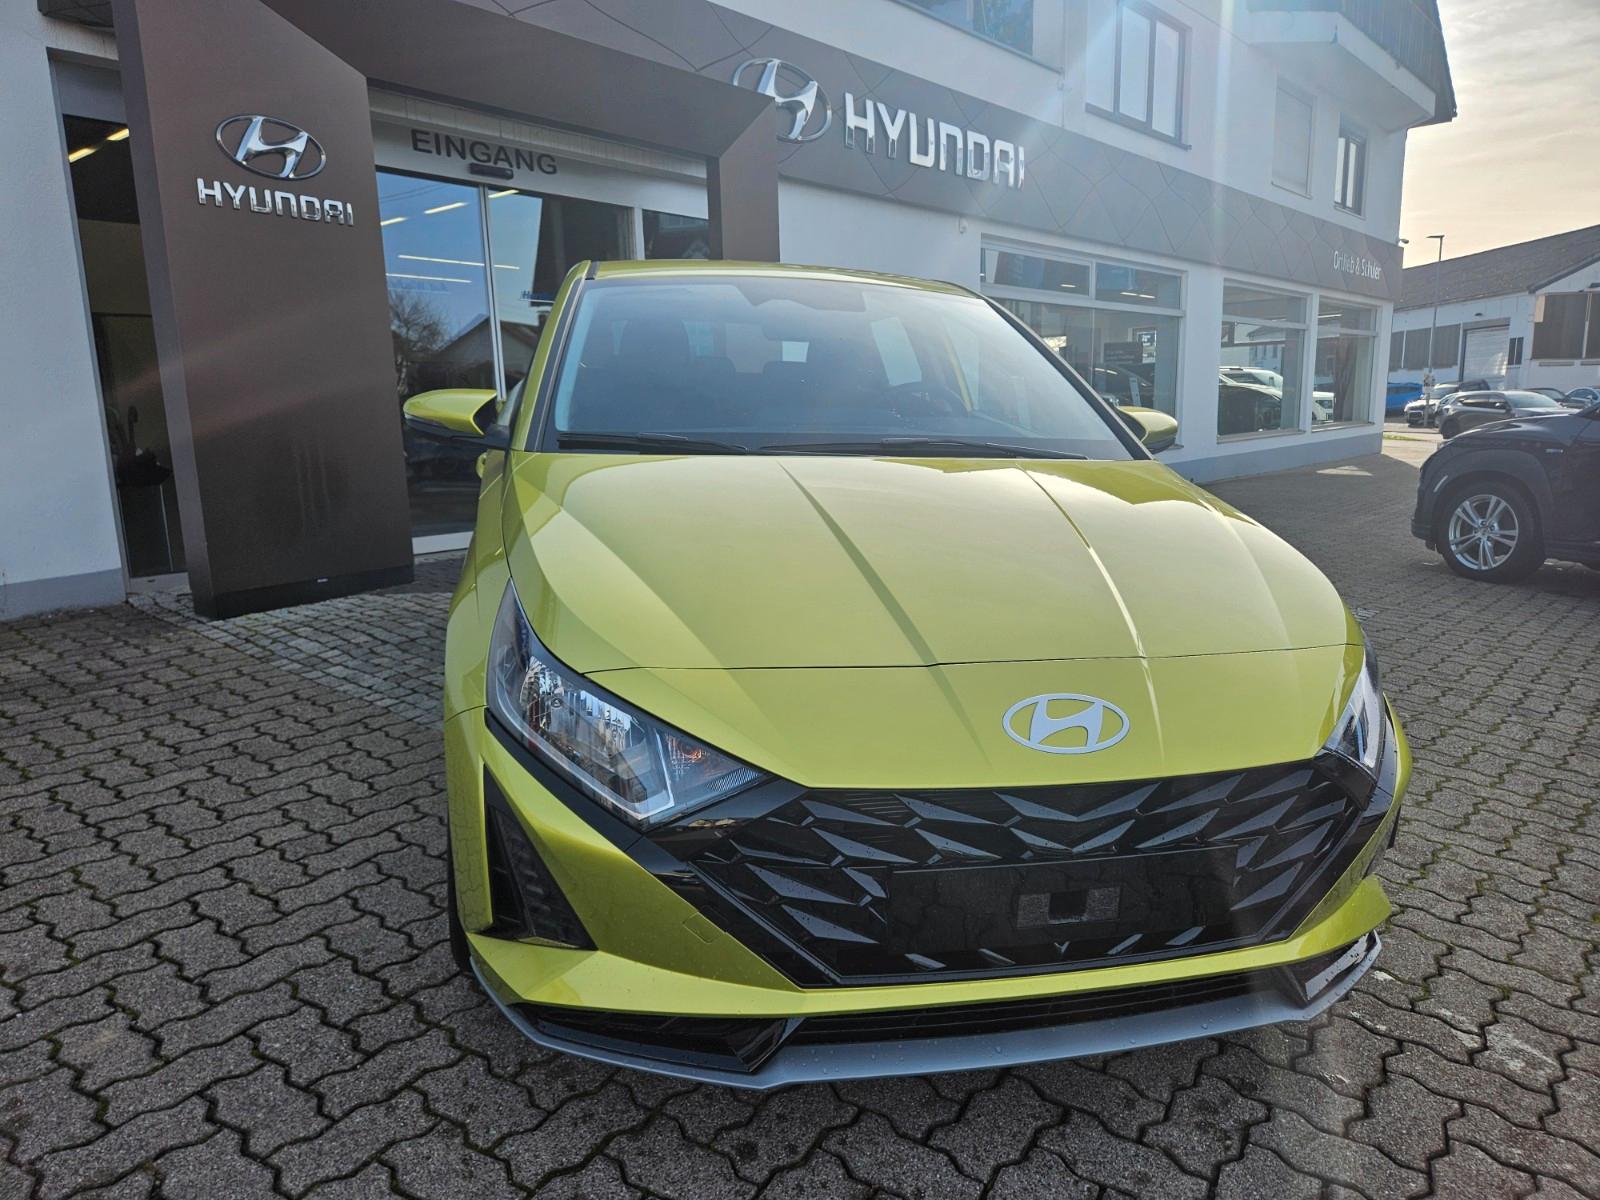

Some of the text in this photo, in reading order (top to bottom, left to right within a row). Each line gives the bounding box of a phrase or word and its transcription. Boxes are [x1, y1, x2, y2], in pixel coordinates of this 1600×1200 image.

[411, 129, 557, 175] EINGANG
[845, 92, 1025, 191] HYUNDAI
[196, 178, 354, 227] HYUNDAI
